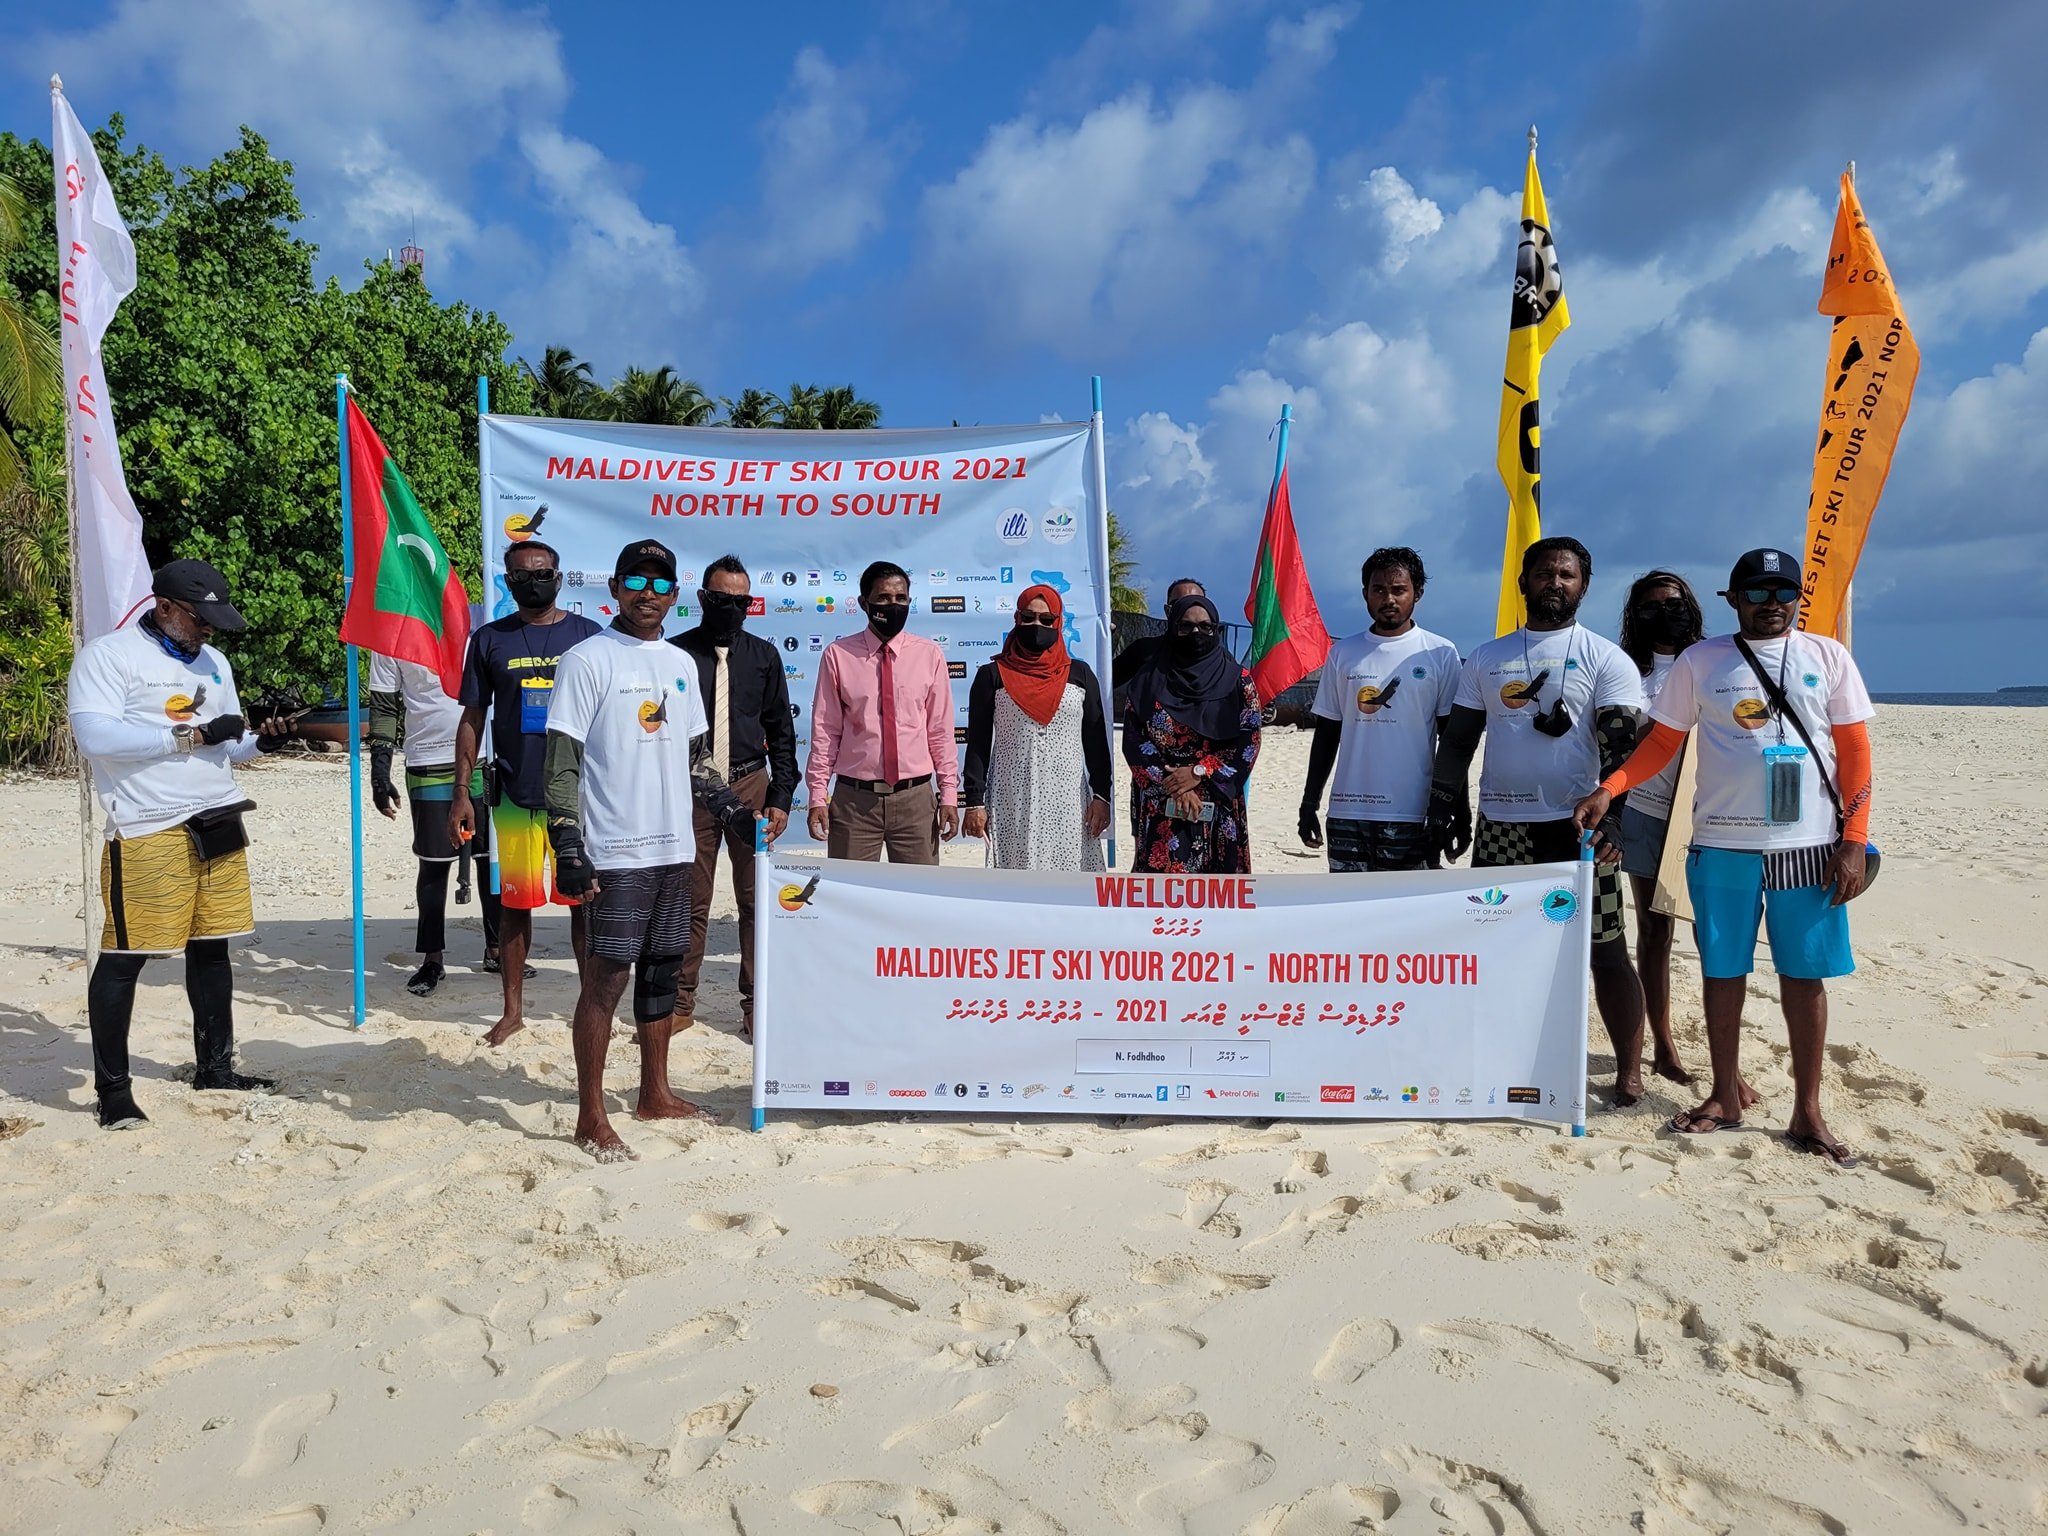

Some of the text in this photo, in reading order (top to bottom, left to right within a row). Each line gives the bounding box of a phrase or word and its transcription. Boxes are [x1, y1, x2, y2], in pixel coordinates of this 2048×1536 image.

[547, 457, 1027, 487] MALDIVES JET SKI TOUR 2021
[1797, 318, 1903, 632] DIVES JET SKI TOUR 2021 NOR
[651, 493, 941, 516] NORTH TO SOUTH
[1715, 687, 1731, 695] Main
[1095, 877, 1257, 909] WELCOME
[876, 947, 998, 979] MALDIVES
[1005, 949, 1045, 980] JET
[1052, 950, 1091, 981] SKI
[1099, 950, 1163, 982] YOUR
[1171, 951, 1234, 983] 2021
[1269, 952, 1350, 984] NORTH
[1358, 954, 1389, 983] TO
[1396, 954, 1477, 985] SOUTH
[1116, 999, 1167, 1022] 2021
[1115, 1051, 1166, 1062] N. Fodhdhoo
[889, 1089, 927, 1098] ooredoo
[1242, 1090, 1260, 1098] Ofisi
